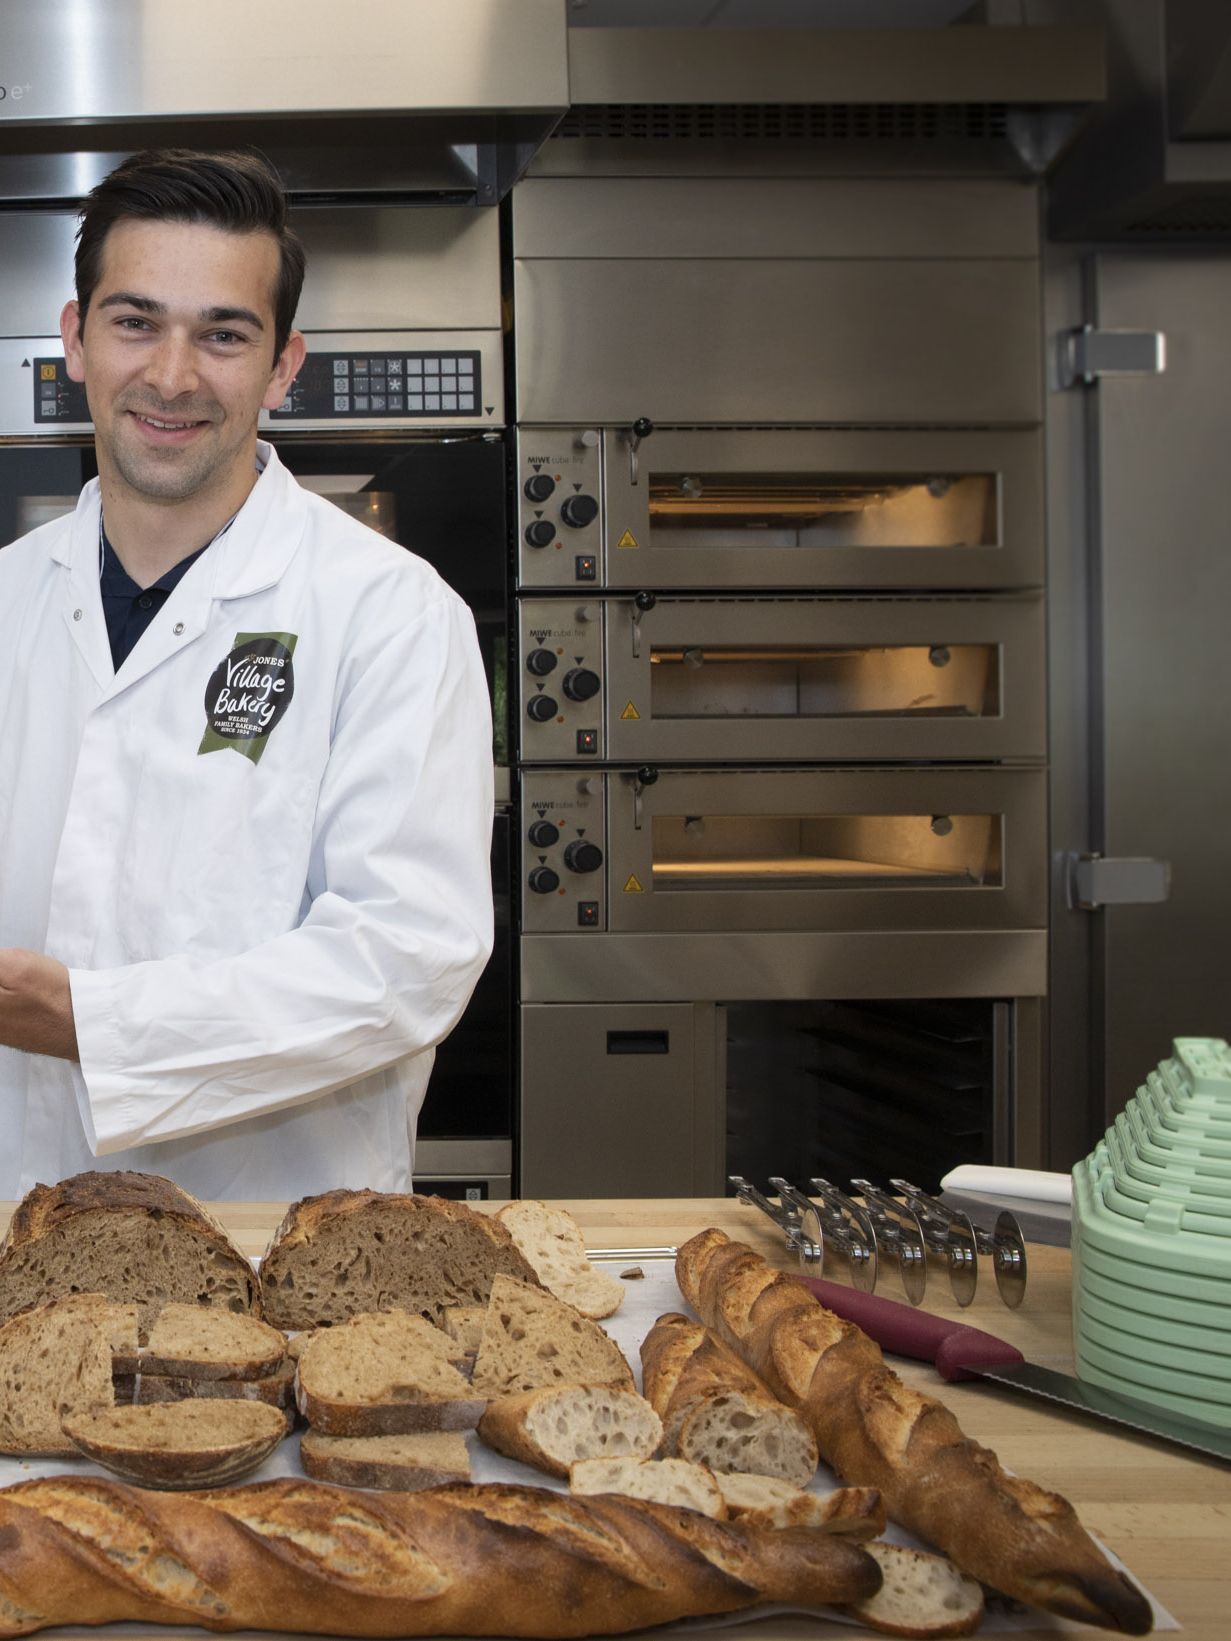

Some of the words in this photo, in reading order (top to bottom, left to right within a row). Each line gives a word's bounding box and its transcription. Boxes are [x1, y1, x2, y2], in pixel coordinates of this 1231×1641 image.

[253, 656, 284, 667] JONES
[226, 658, 286, 701] Village
[214, 688, 276, 726] Bakery
[235, 723, 262, 733] BAKERS
